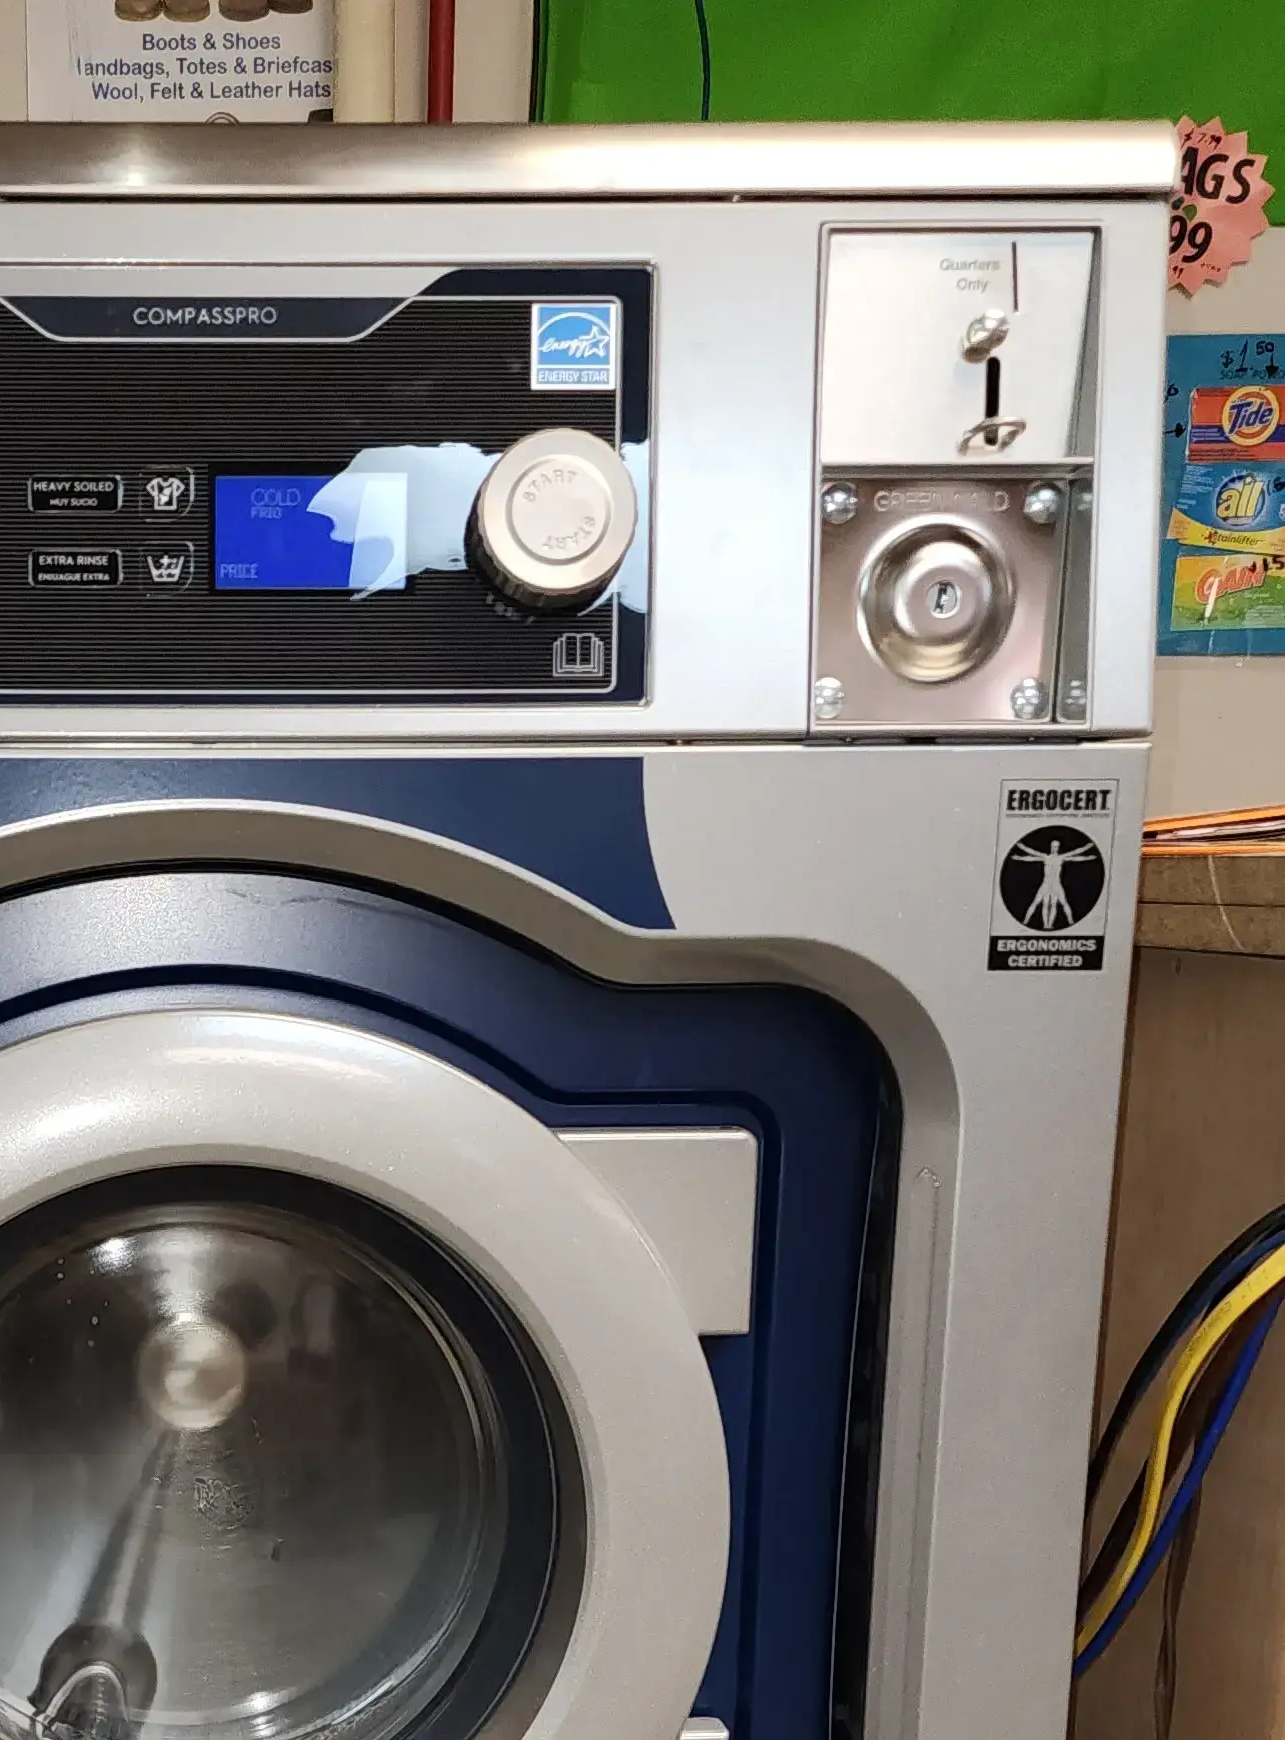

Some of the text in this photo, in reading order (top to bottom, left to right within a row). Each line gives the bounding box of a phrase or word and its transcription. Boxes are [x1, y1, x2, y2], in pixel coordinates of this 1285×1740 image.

[142, 32, 281, 51] Boots & Shoes
[175, 57, 227, 75] Totes
[233, 57, 247, 75] &
[253, 56, 334, 75] Briefcas
[92, 81, 332, 102] Wool, Felt & Leather Hats
[939, 257, 1001, 272] Quarters
[955, 277, 990, 293] Only
[132, 306, 279, 325] COMPASSPRO
[538, 370, 608, 383] ENERGY STAR
[1227, 400, 1275, 435] Tide
[33, 481, 115, 492] HEAVY SOILED
[522, 468, 580, 503] START
[250, 487, 302, 507] COLD
[1217, 473, 1265, 519] all
[38, 555, 109, 566] EXTRA RINSE
[219, 562, 259, 579] PRICE
[1006, 788, 1112, 811] ERGOCERT
[996, 938, 1098, 952] ERGONOMICS
[1007, 954, 1084, 968] CERTIFIED
